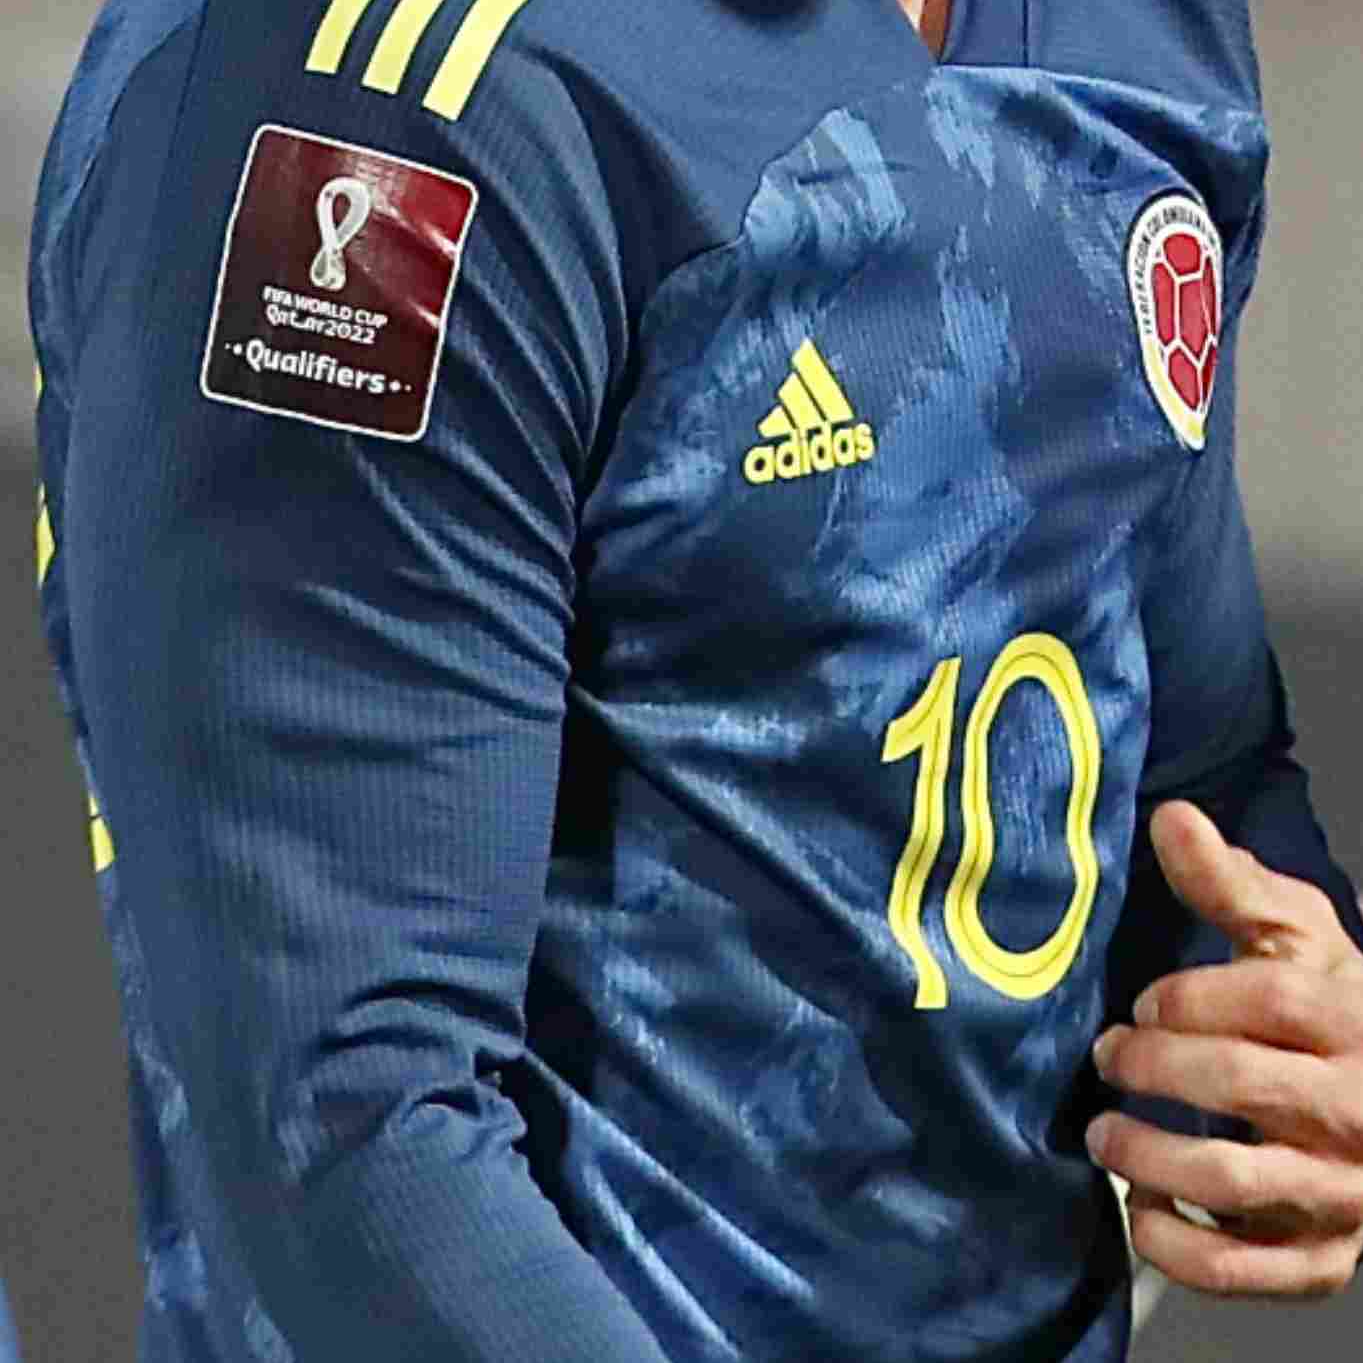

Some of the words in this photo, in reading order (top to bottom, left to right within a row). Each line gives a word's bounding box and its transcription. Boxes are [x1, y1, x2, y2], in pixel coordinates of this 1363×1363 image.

[263, 285, 293, 307] FIFA
[294, 294, 352, 320] WORLD
[354, 309, 388, 328] CUP
[246, 338, 386, 394] Qualifiers
[744, 422, 875, 483] adidas
[881, 632, 1100, 1010] 10
